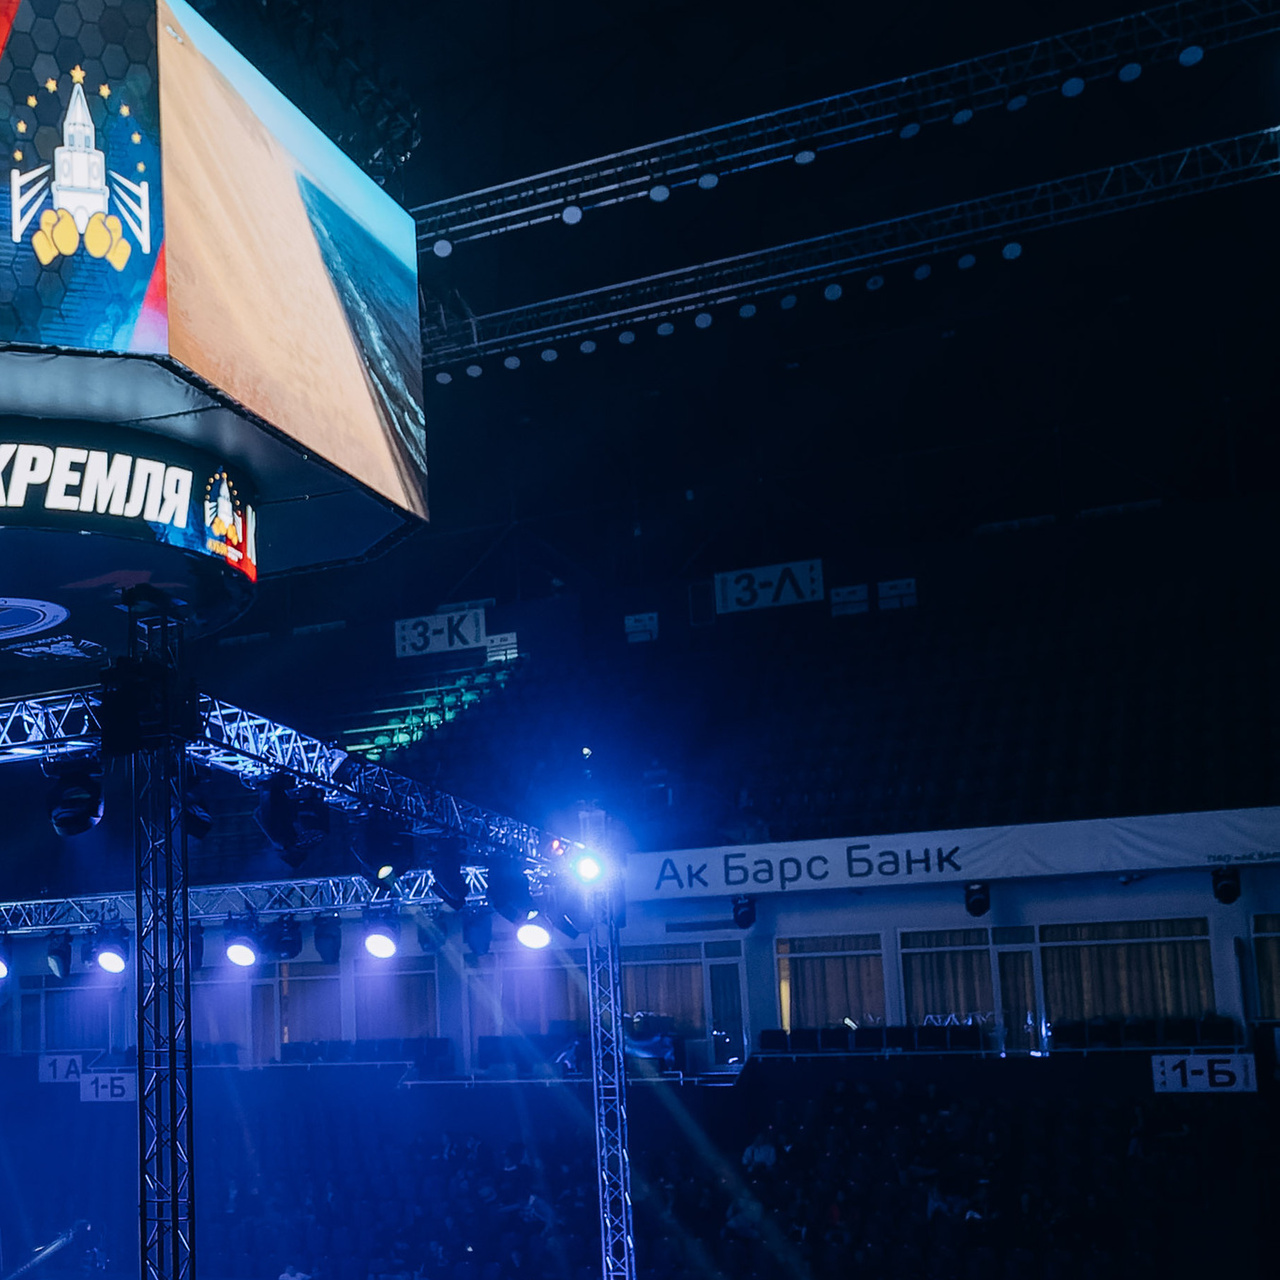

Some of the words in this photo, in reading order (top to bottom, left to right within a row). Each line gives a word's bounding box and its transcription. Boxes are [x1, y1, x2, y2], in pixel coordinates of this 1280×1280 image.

[734, 567, 806, 607] 3-Л
[410, 614, 471, 654] 3-К
[655, 858, 709, 891] Ак
[723, 852, 831, 890] Барс
[846, 843, 963, 878] Банк
[90, 1076, 127, 1099] 1-Б
[1171, 1058, 1238, 1089] 1-Б
